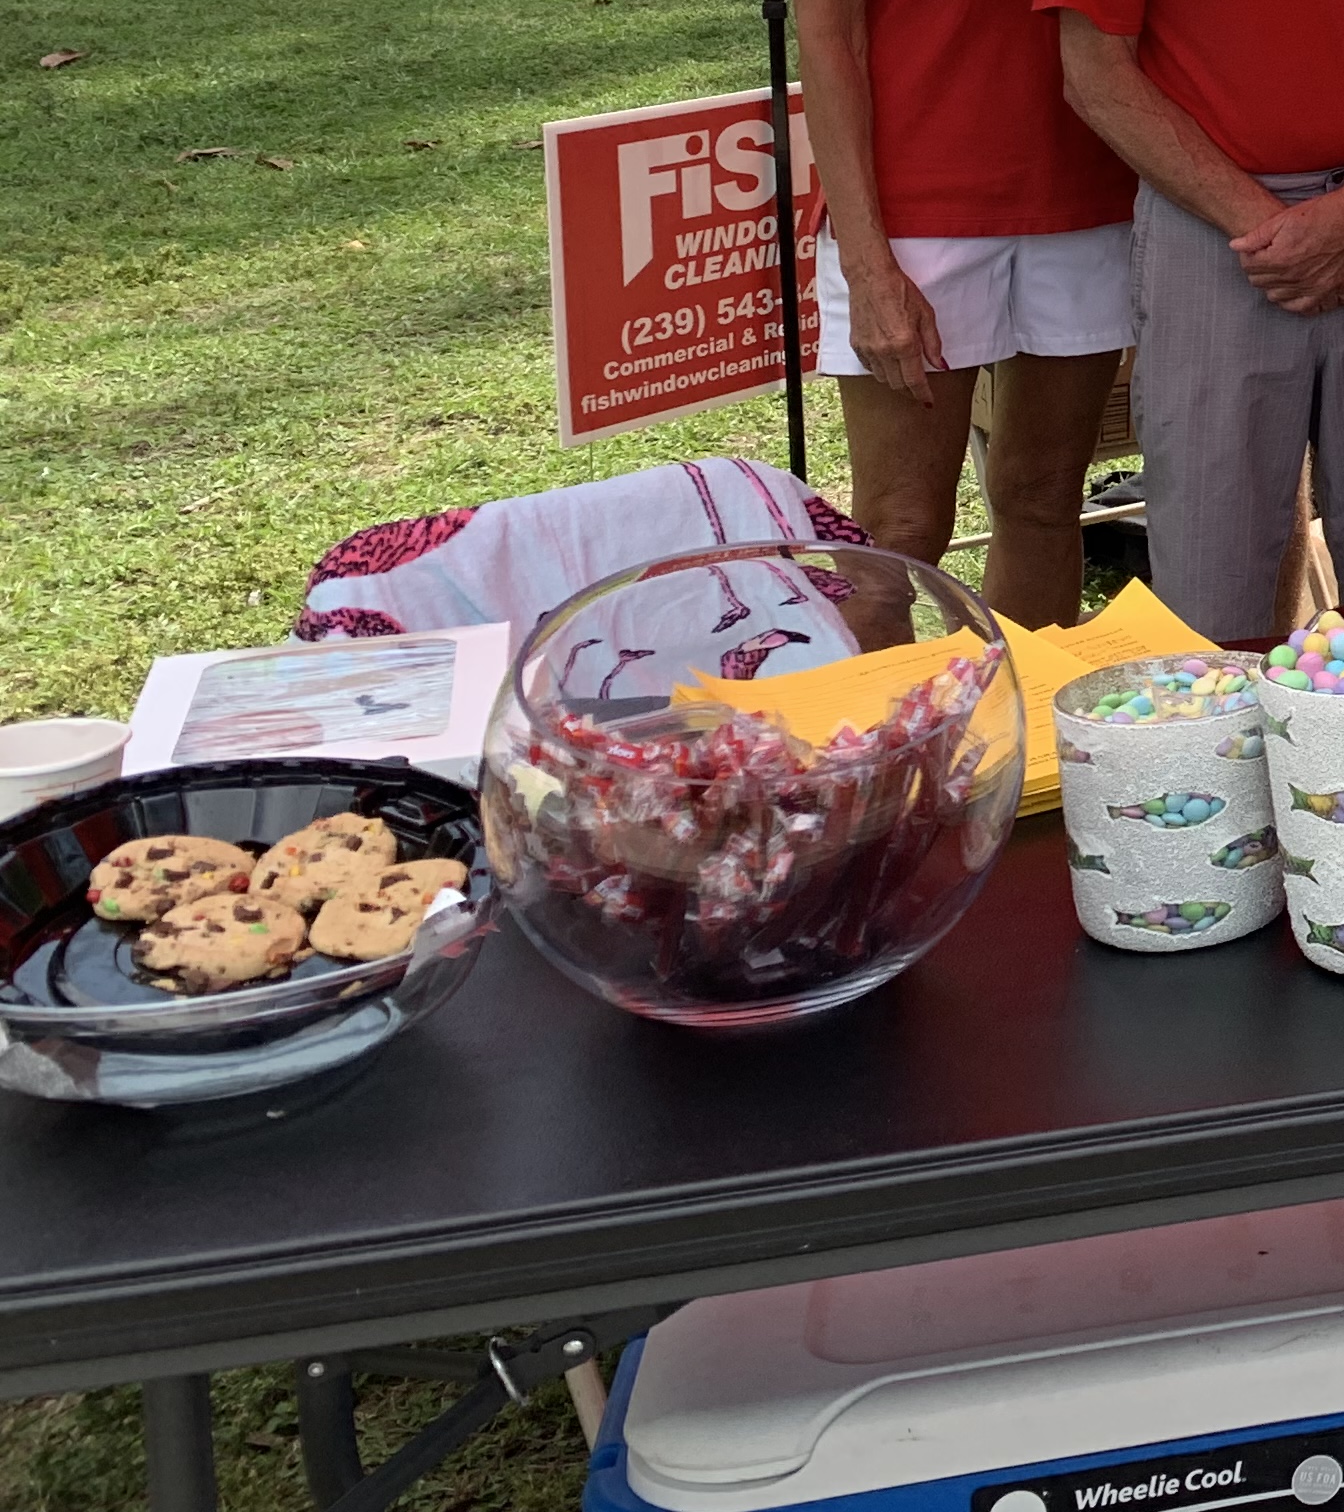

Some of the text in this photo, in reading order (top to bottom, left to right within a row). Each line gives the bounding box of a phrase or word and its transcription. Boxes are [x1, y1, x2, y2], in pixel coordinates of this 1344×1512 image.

[676, 209, 802, 259] WINDO
[603, 332, 735, 381] Commercial
[742, 326, 757, 345] &
[621, 304, 705, 355] (239)
[1075, 1474, 1179, 1510] Wheelie
